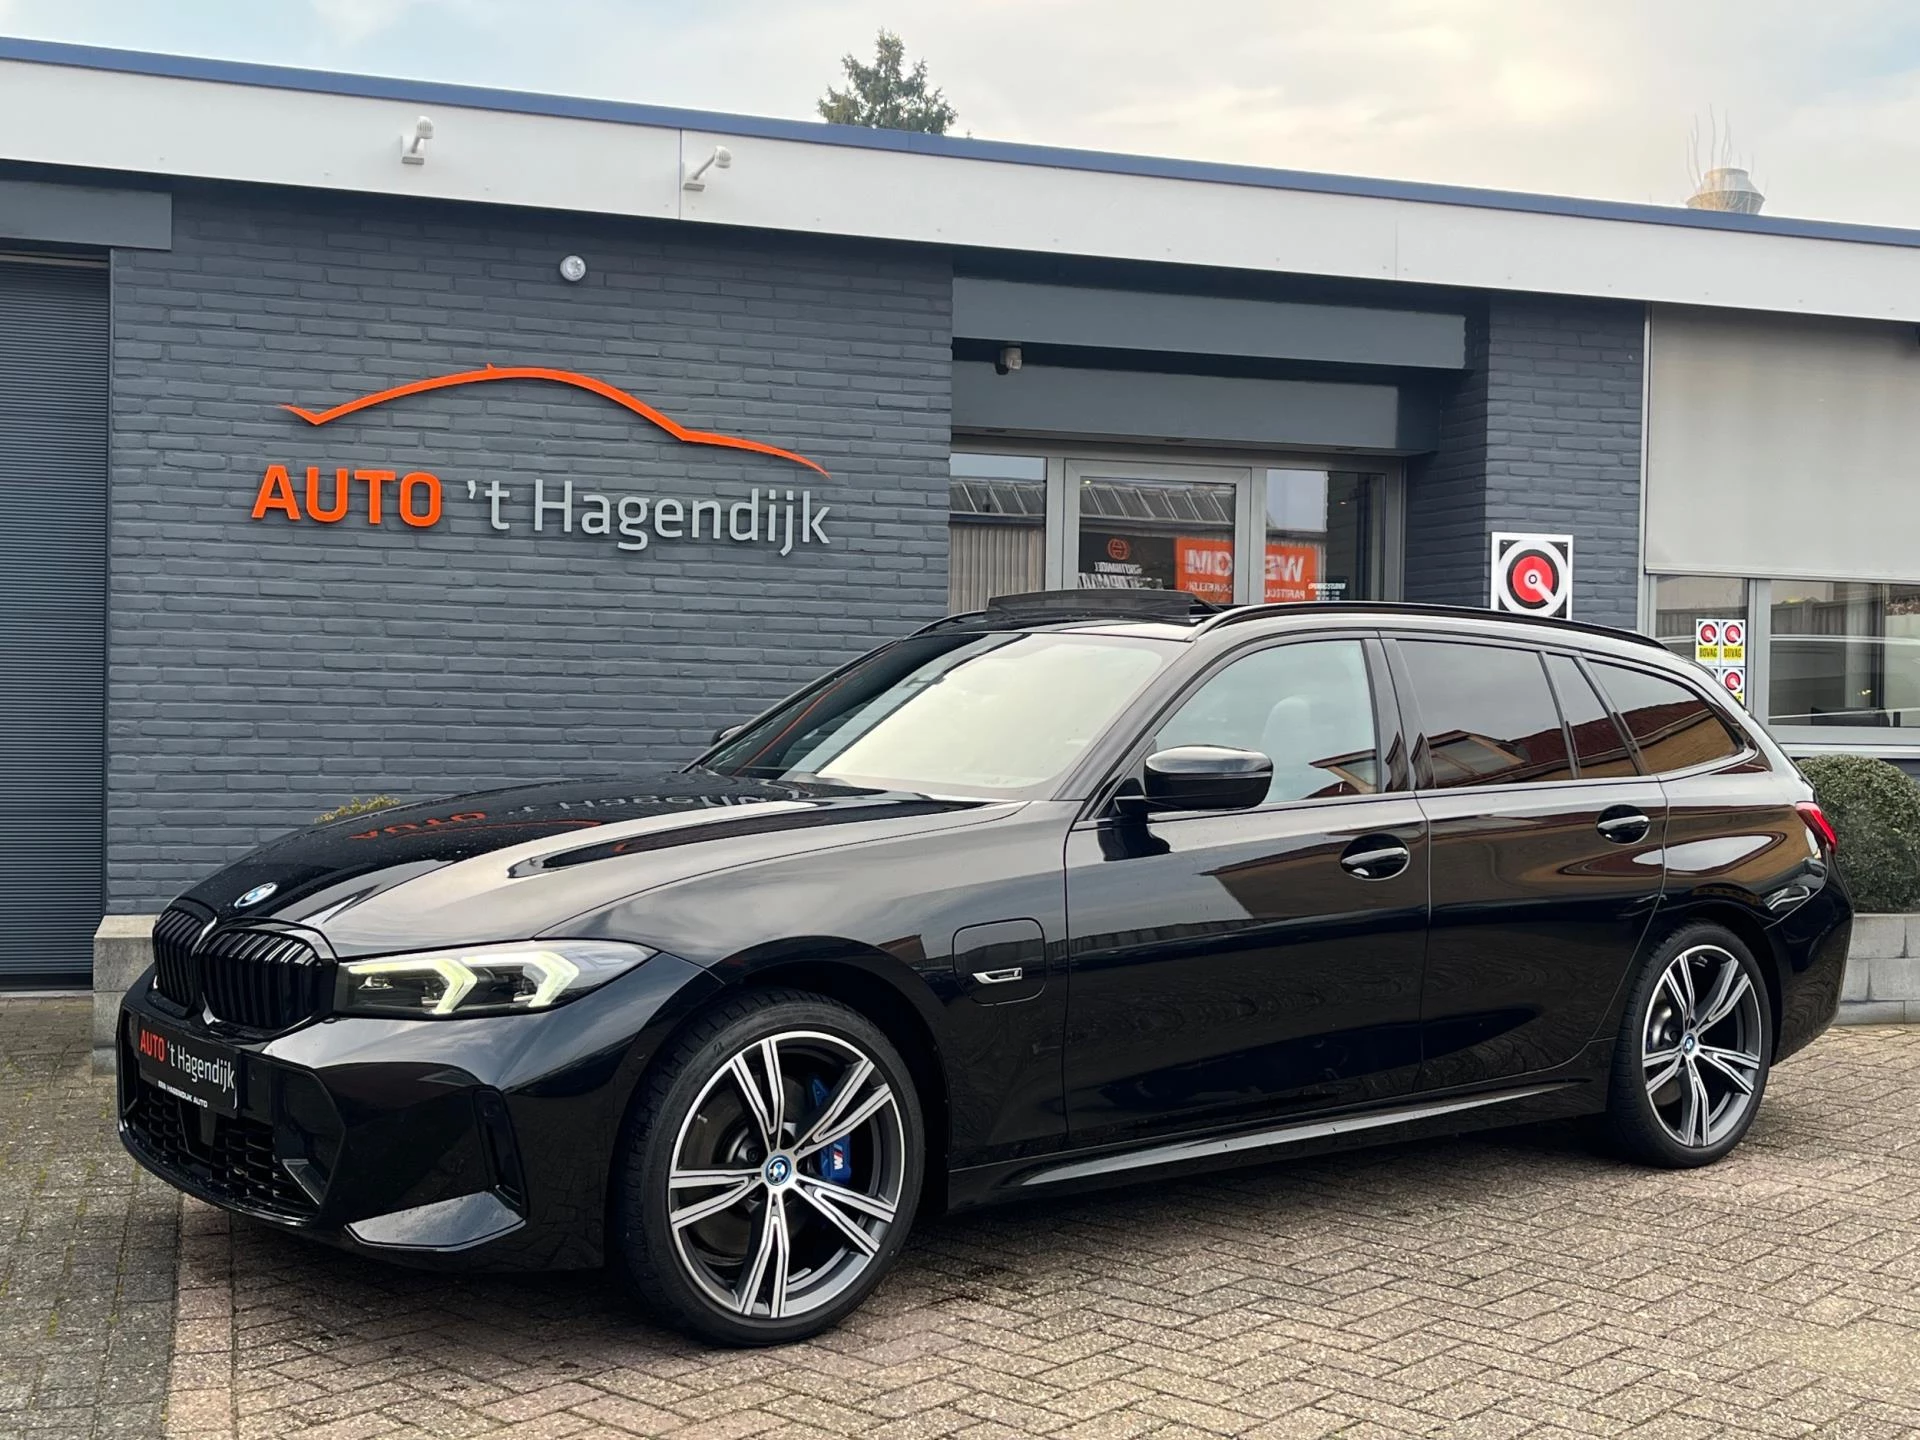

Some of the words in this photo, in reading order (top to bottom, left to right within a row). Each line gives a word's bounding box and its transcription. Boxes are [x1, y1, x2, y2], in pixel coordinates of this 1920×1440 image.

[251, 464, 442, 528] AUTO
[466, 479, 511, 531] 't
[533, 478, 831, 557] Hagendijk
[1699, 647, 1718, 658] BOVAG
[1724, 647, 1742, 658] BOVAG
[140, 1028, 166, 1062] AUTO
[177, 1044, 235, 1093] Hagendijk
